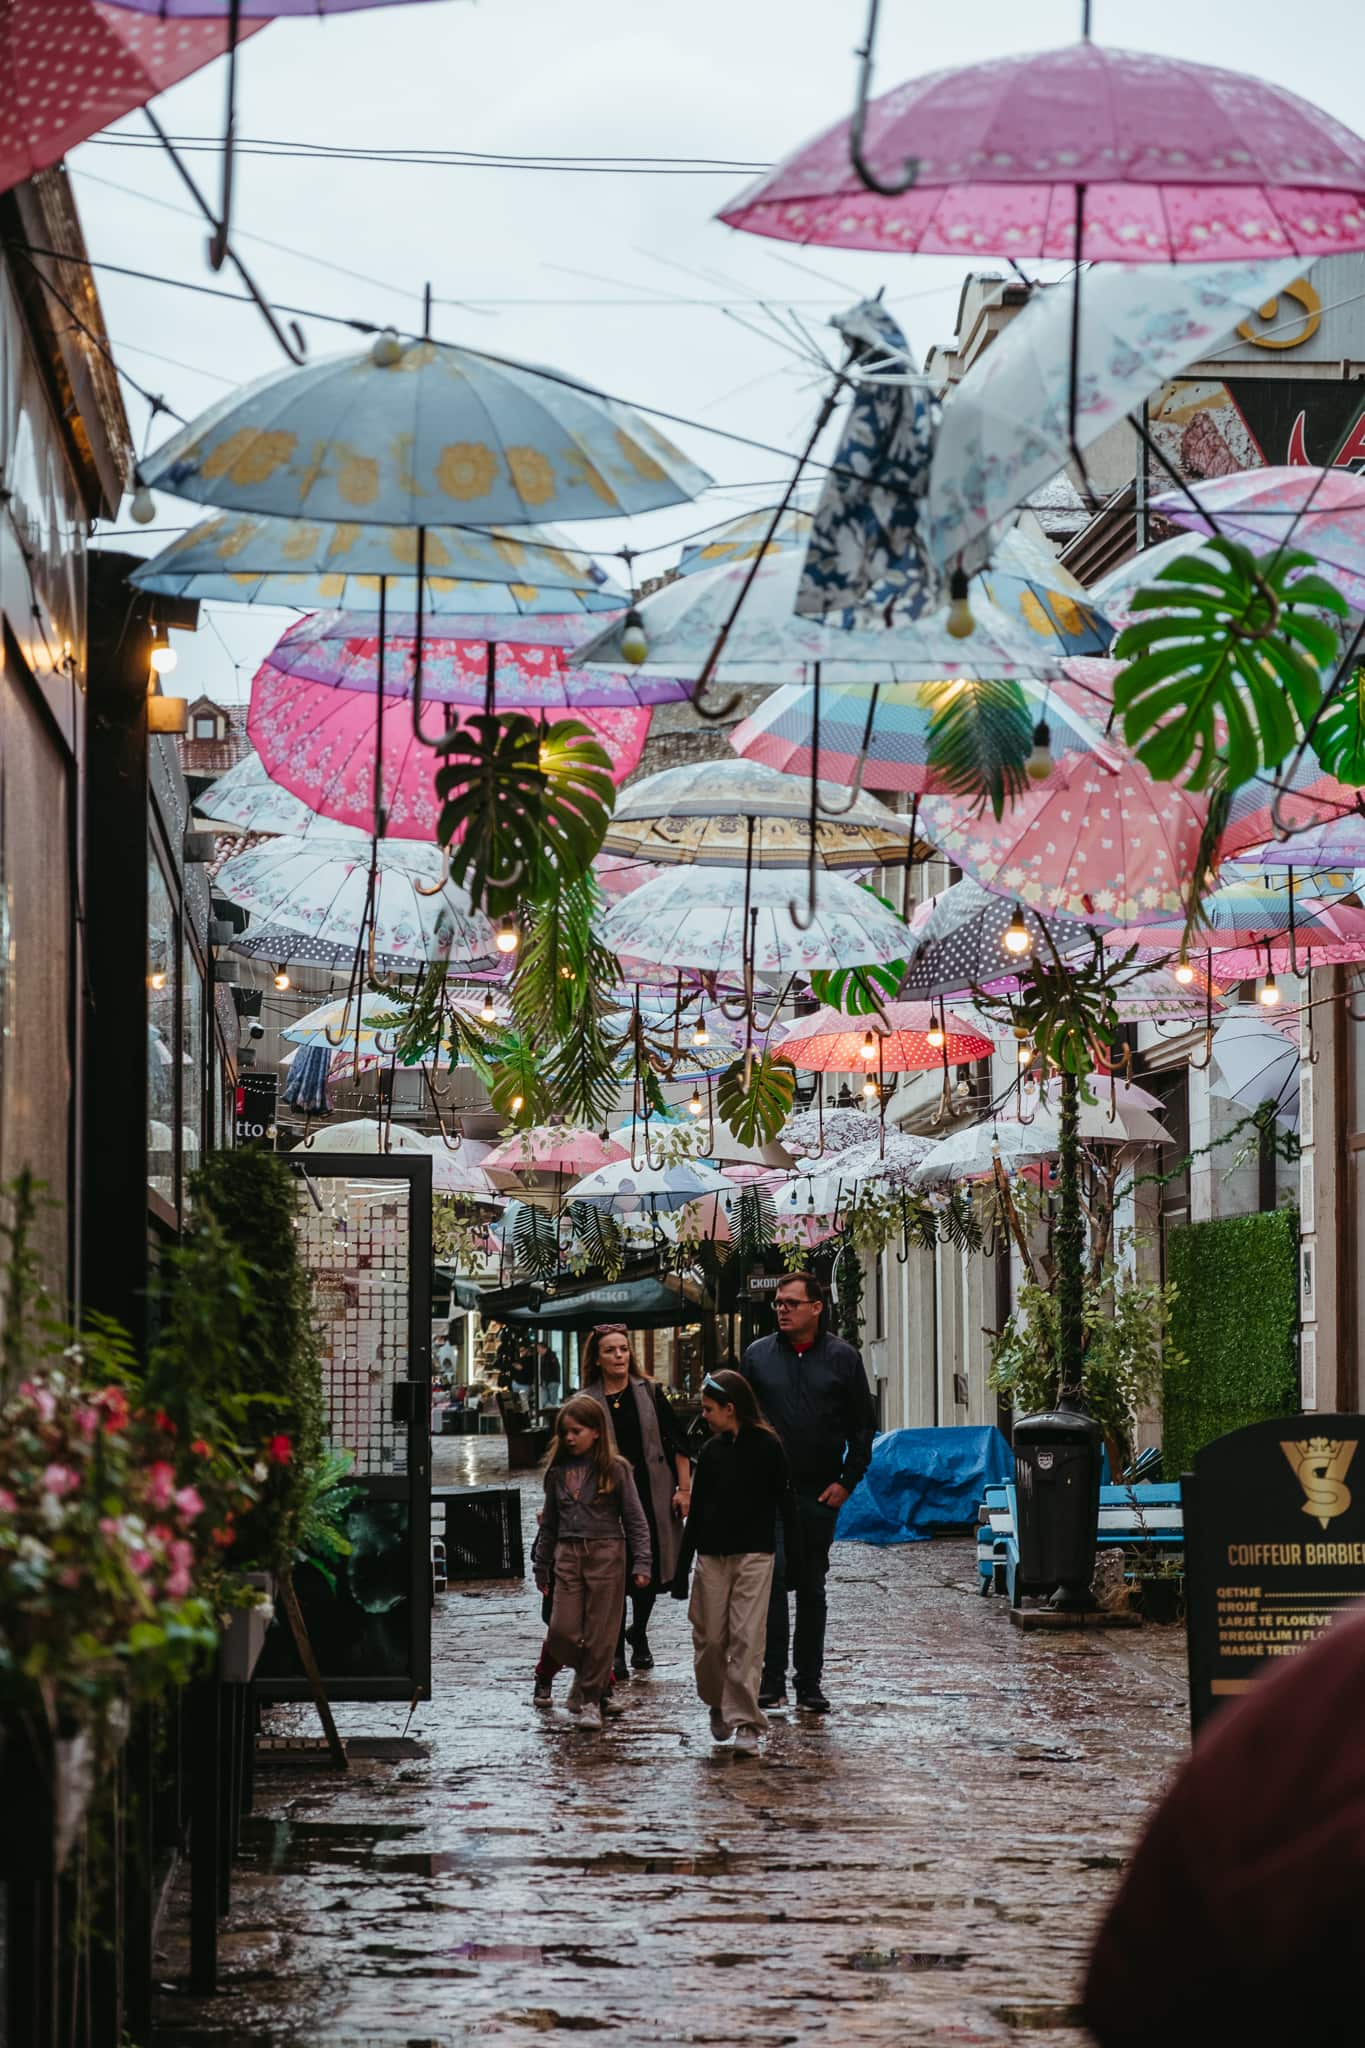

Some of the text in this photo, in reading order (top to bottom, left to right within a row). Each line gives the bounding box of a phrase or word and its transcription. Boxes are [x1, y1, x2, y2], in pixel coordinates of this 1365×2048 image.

[1228, 1544, 1302, 1566] COIFFEUR
[1216, 1587, 1262, 1598] QETHJE
[1219, 1616, 1257, 1626] LARJE
[1276, 1613, 1332, 1626] FLOKËVE
[1219, 1630, 1328, 1640] RREGULLIM I FLO
